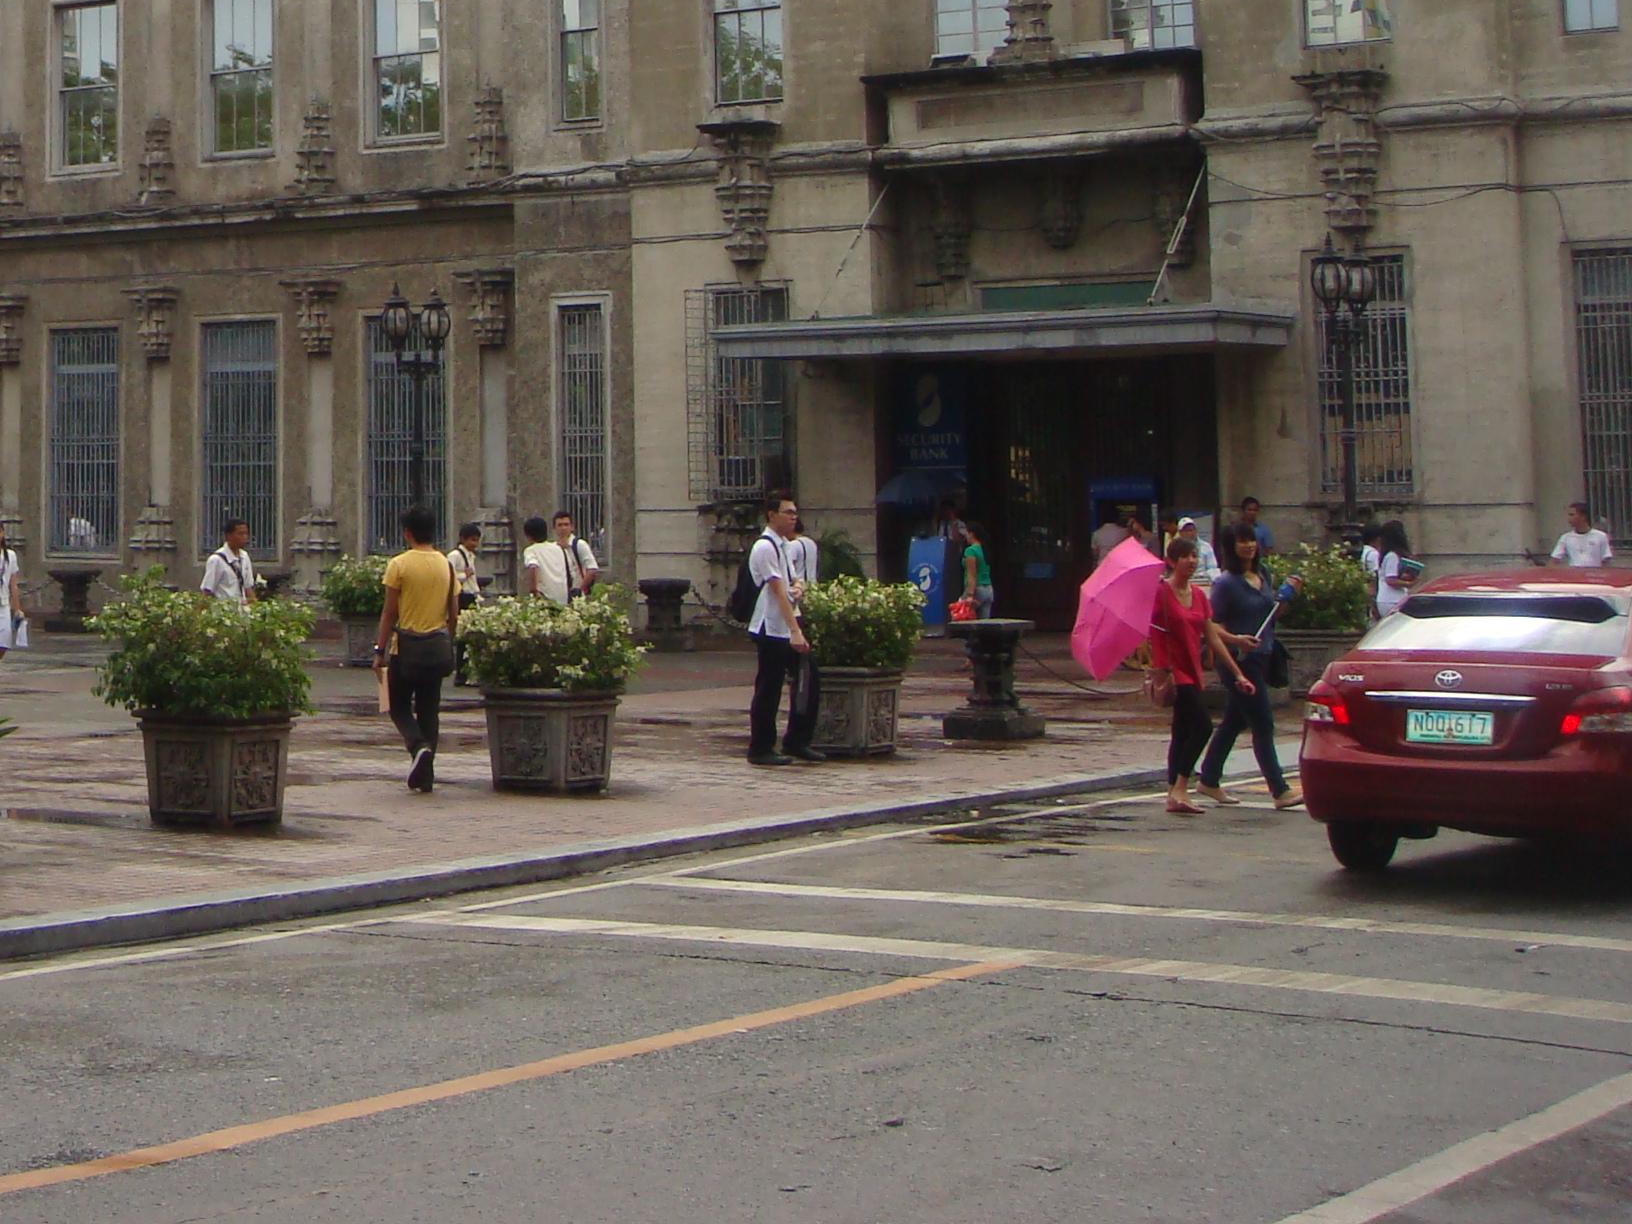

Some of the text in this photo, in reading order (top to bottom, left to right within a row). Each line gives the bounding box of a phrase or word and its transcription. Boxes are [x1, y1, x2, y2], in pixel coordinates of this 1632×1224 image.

[896, 432, 961, 447] SECURITY
[909, 447, 949, 461] BANK
[1454, 716, 1488, 735] 617
